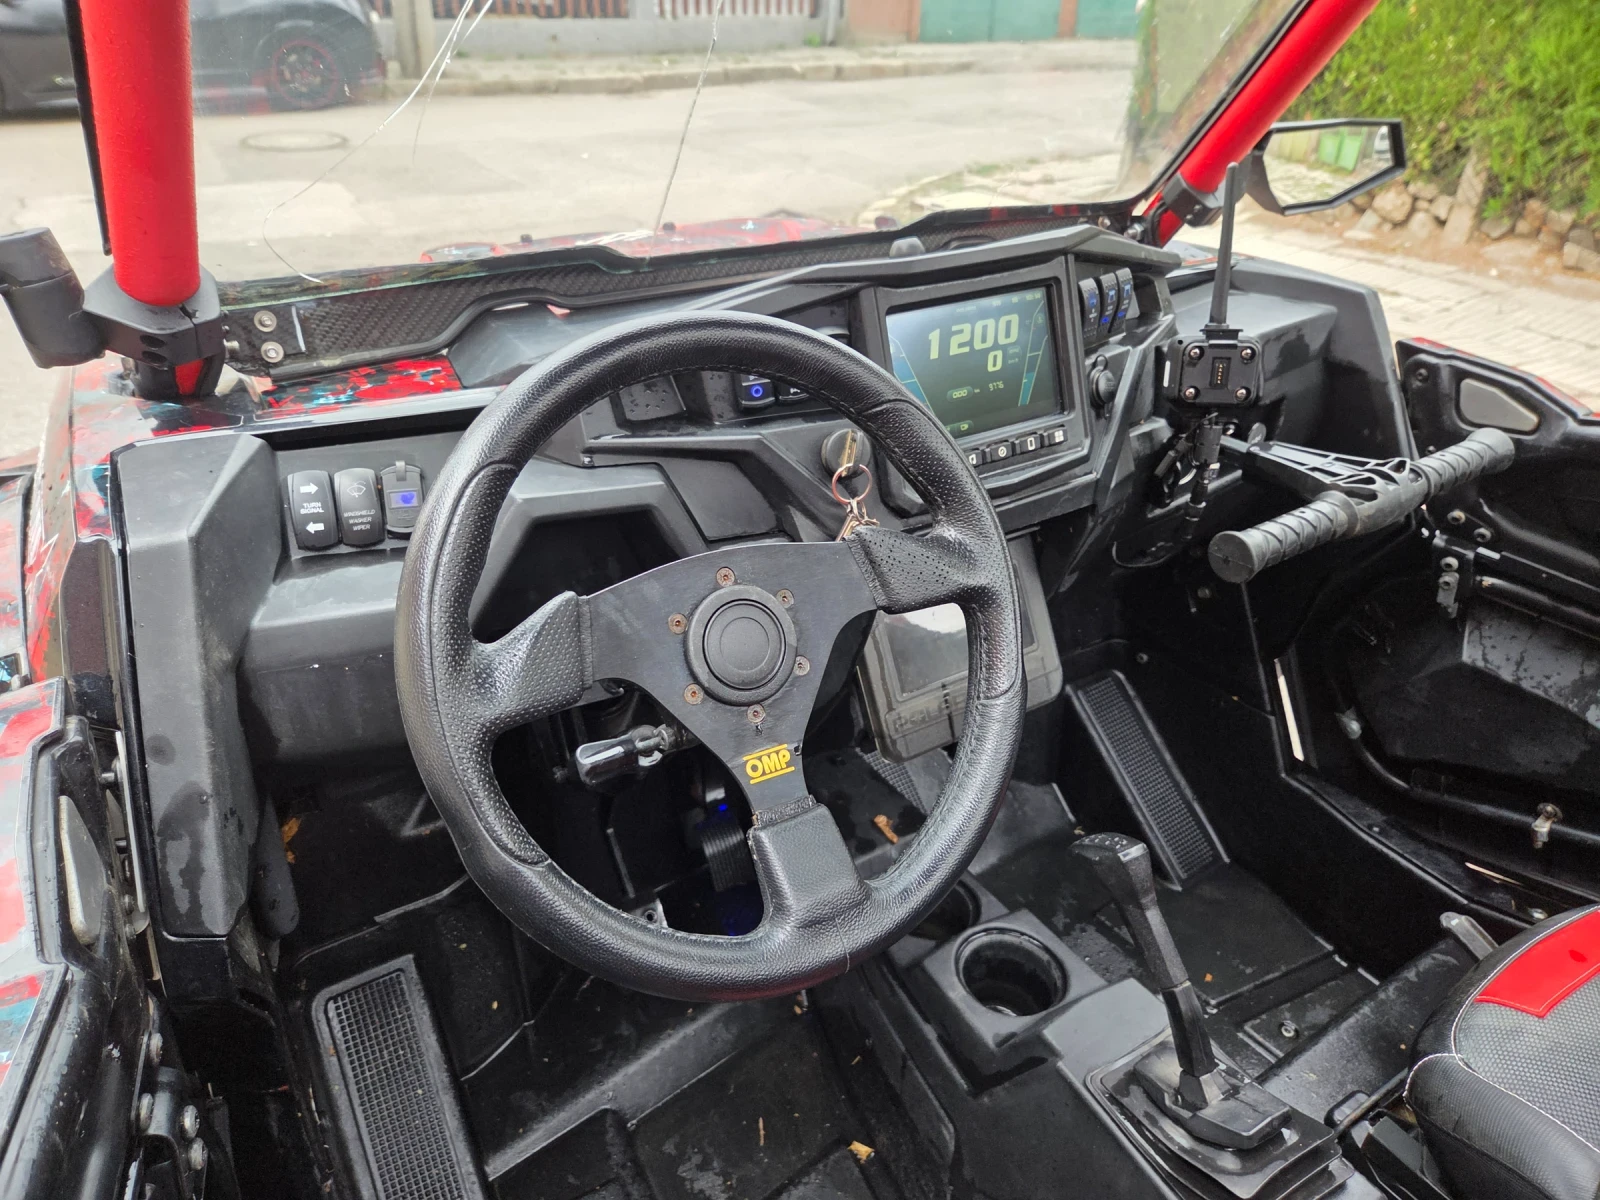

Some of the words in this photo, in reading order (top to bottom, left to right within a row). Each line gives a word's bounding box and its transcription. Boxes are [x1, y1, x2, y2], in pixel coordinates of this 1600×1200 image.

[928, 313, 1019, 360] 1200
[987, 349, 1003, 372] 0
[300, 507, 325, 515] SIGNAL
[343, 509, 376, 517] WINDSHIELD
[745, 749, 791, 778] OMP
